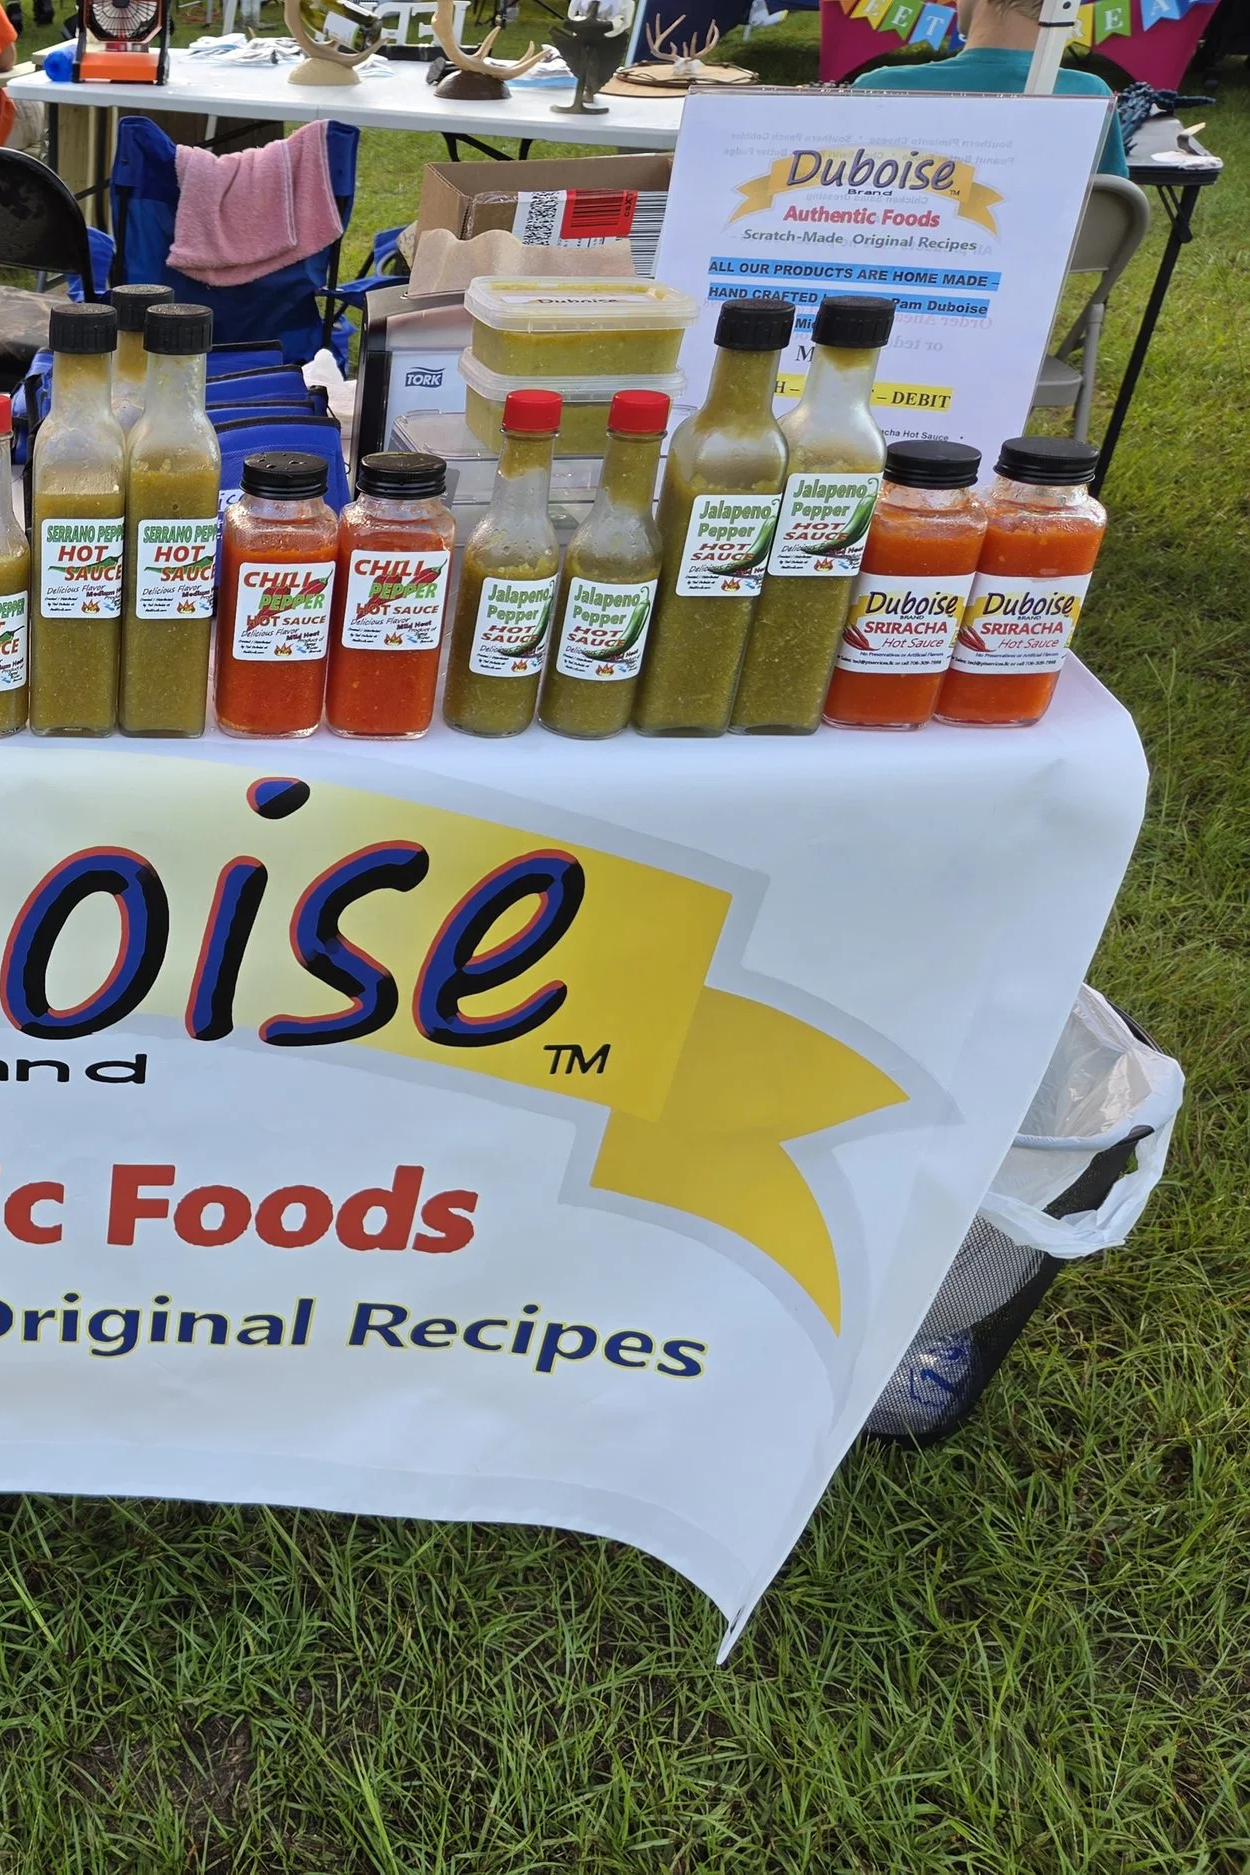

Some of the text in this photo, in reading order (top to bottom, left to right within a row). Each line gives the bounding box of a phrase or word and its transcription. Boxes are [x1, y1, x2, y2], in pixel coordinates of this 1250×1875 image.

[786, 148, 958, 191] Duboise
[847, 188, 893, 197] Brand
[783, 205, 940, 228] Authentic Foods
[742, 228, 978, 252] Scratch-Made Original Recipes
[709, 261, 989, 288] ALL OUR PRODUCTS ARE HOME MADE
[709, 286, 819, 304] HAND CRAFTED
[926, 300, 989, 316] Duboise
[406, 374, 442, 386] TORK
[891, 391, 952, 409] DEBIT
[903, 428, 919, 438] Hot
[921, 430, 949, 442] Sauce
[793, 478, 868, 501] Jalapeno
[699, 500, 772, 524] Jalapeno
[790, 502, 851, 521] Pepper
[46, 525, 96, 543] SERRANO
[143, 525, 192, 544] SERRANO
[697, 523, 756, 541] Pepper
[792, 522, 847, 531] HOT
[783, 531, 849, 541] SAUCE
[58, 545, 109, 562] HOT
[154, 545, 206, 562] HOT
[698, 543, 752, 551] HOT
[690, 552, 755, 561] SAUCE
[64, 566, 122, 582] SAUCE
[354, 559, 425, 577] CHILI
[244, 571, 312, 589] CHILI
[368, 582, 438, 600] PEPPER
[488, 583, 550, 608] Jalapeno
[574, 584, 641, 609] Jalapeno
[258, 593, 326, 610] PEPPER
[356, 603, 440, 616] HOT SAUCE
[865, 591, 959, 616] Duboise
[982, 591, 1076, 617] Duboise
[246, 615, 327, 628] HOT SAUCE
[350, 616, 410, 626] Delicious Flavor
[486, 604, 539, 626] Pepper
[572, 604, 627, 627] Pepper
[241, 627, 300, 637] Delicious Flavor
[488, 625, 536, 634] HOT
[574, 625, 623, 638] HOT
[863, 620, 949, 635] SRIRACHA
[980, 621, 1064, 635] SRIRACHA
[480, 633, 538, 644] SAUCE
[567, 633, 626, 647] SAUCE
[881, 638, 945, 648] Hot Sauce
[998, 638, 1060, 649] Hot Sauce
[543, 1044, 610, 1075] TM
[106, 1164, 479, 1254] Foods
[347, 1300, 709, 1380] Recipes
